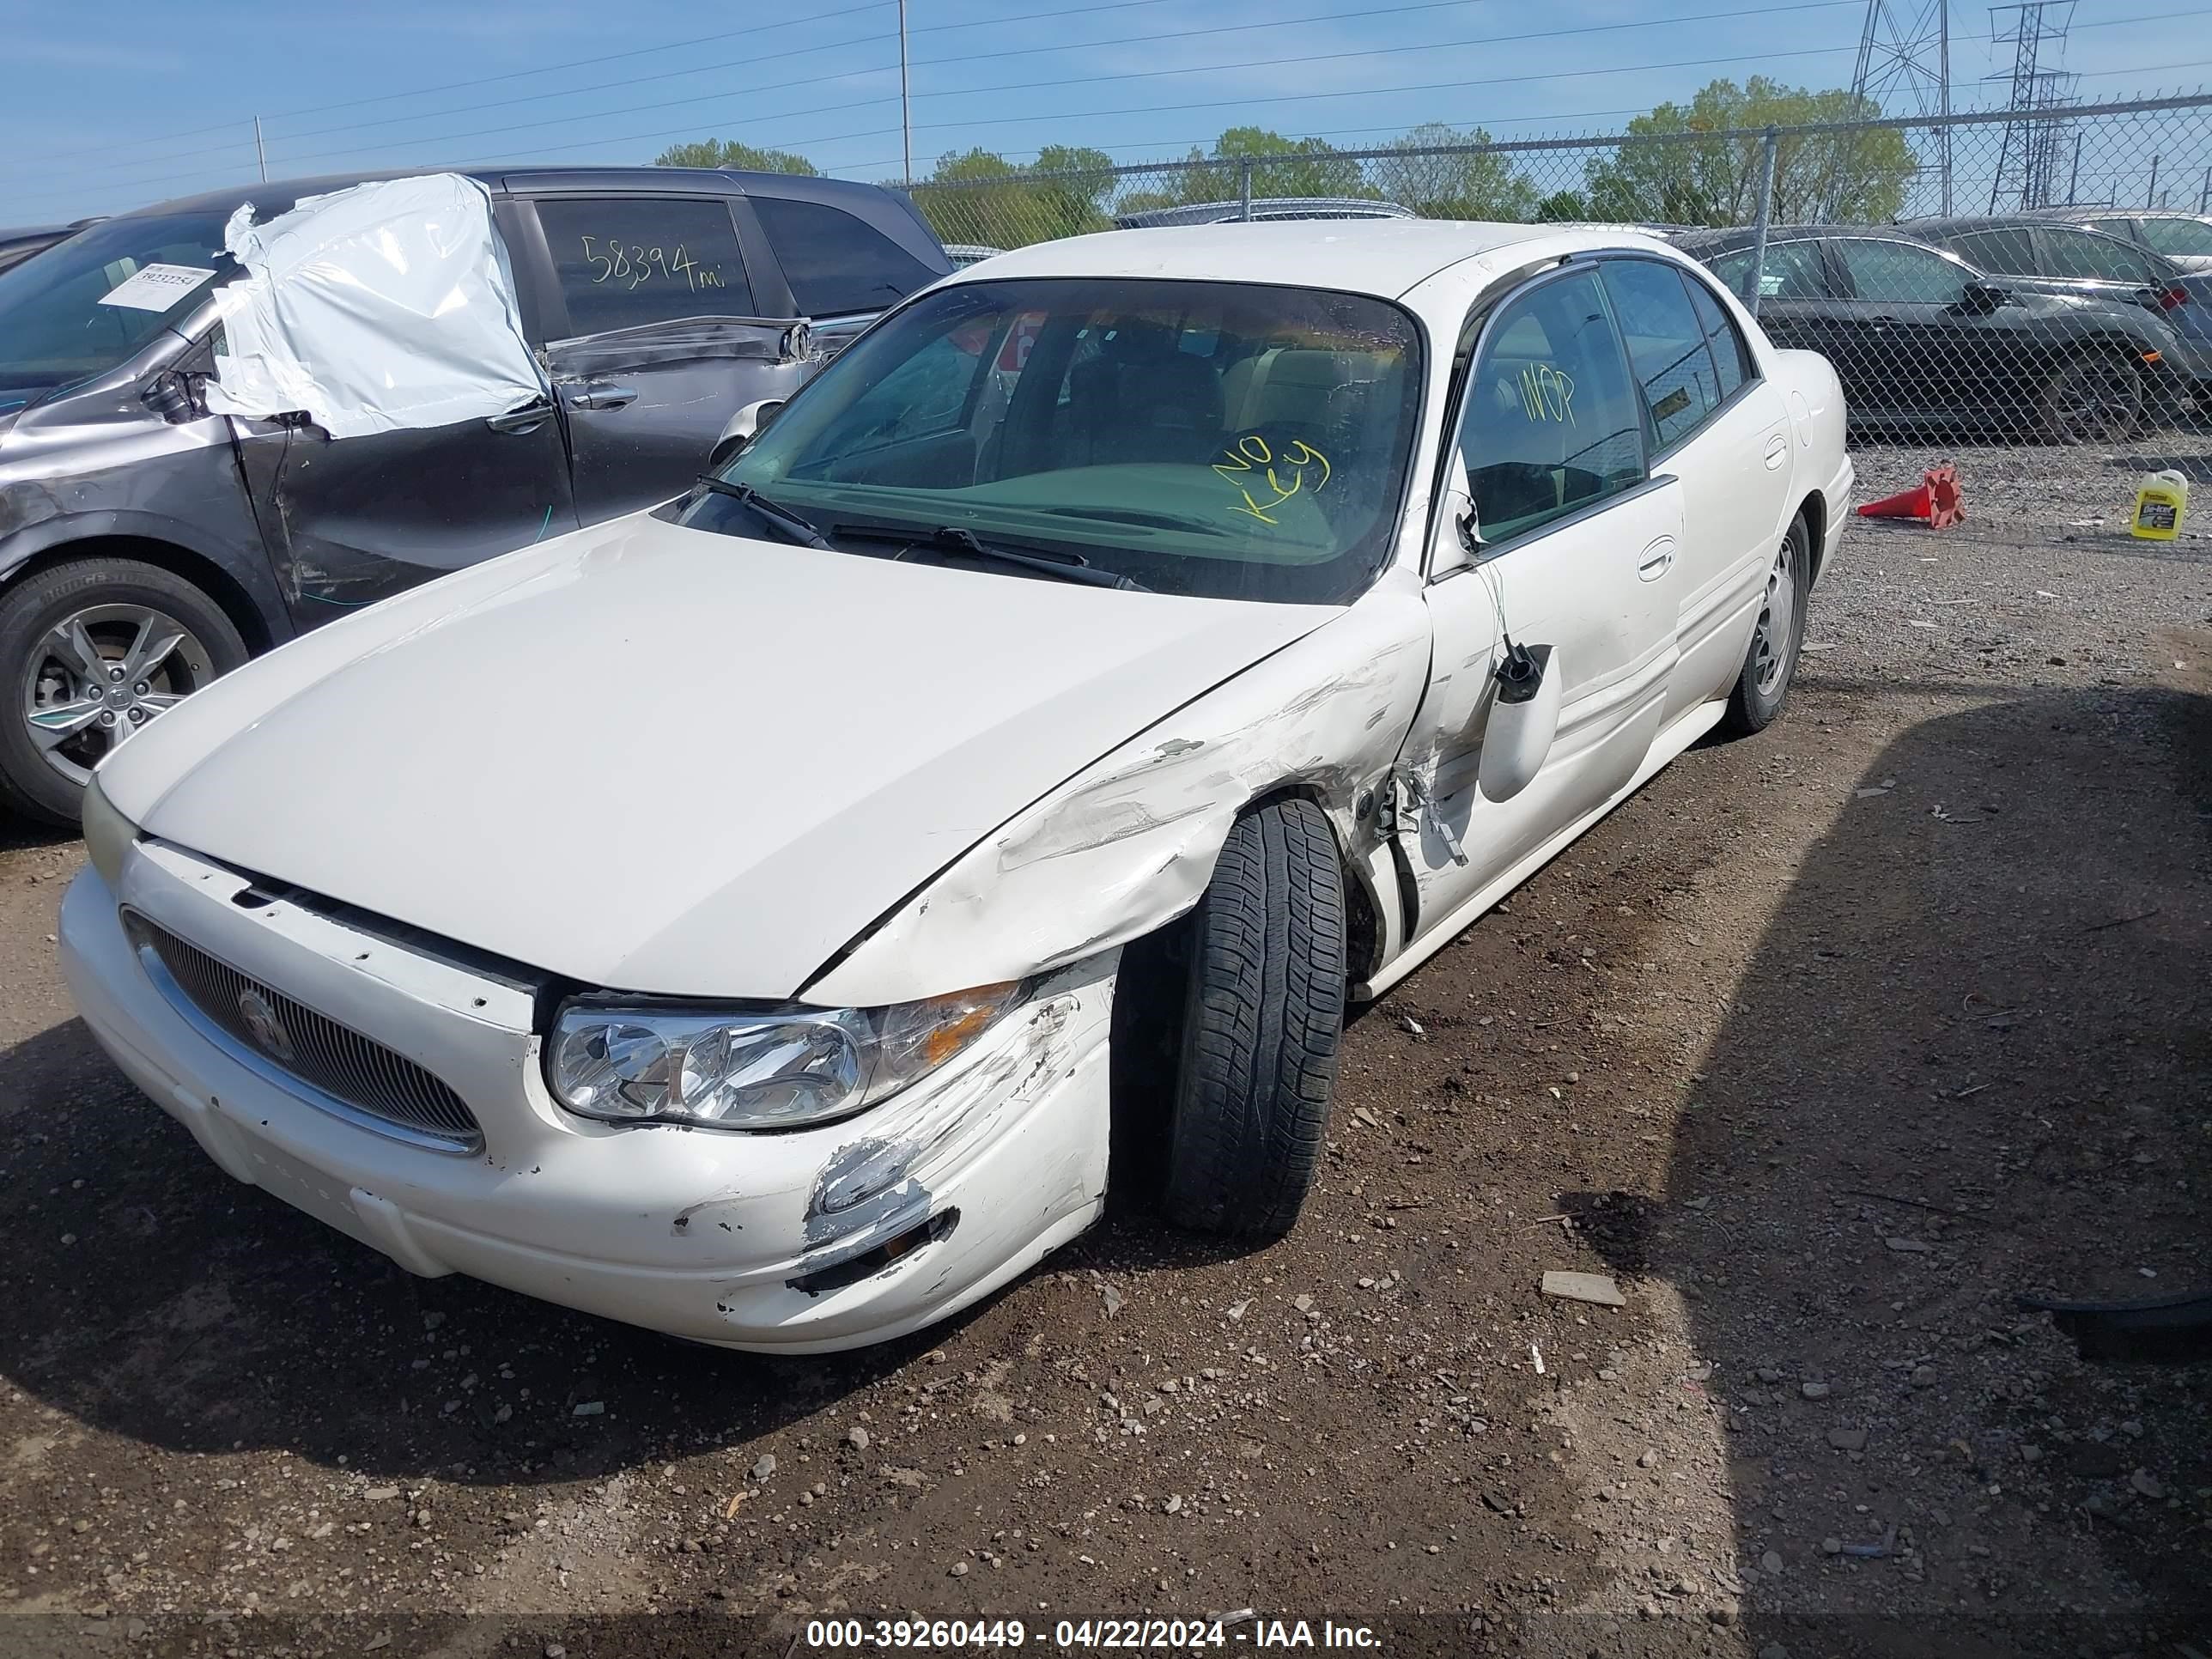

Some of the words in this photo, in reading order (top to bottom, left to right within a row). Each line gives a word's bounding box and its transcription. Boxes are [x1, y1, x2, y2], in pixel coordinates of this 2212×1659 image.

[137, 272, 197, 286] 39232254
[581, 236, 698, 293] 58,394
[700, 264, 725, 288] mi
[1516, 362, 1576, 428] INOP
[1212, 436, 1271, 485] NO
